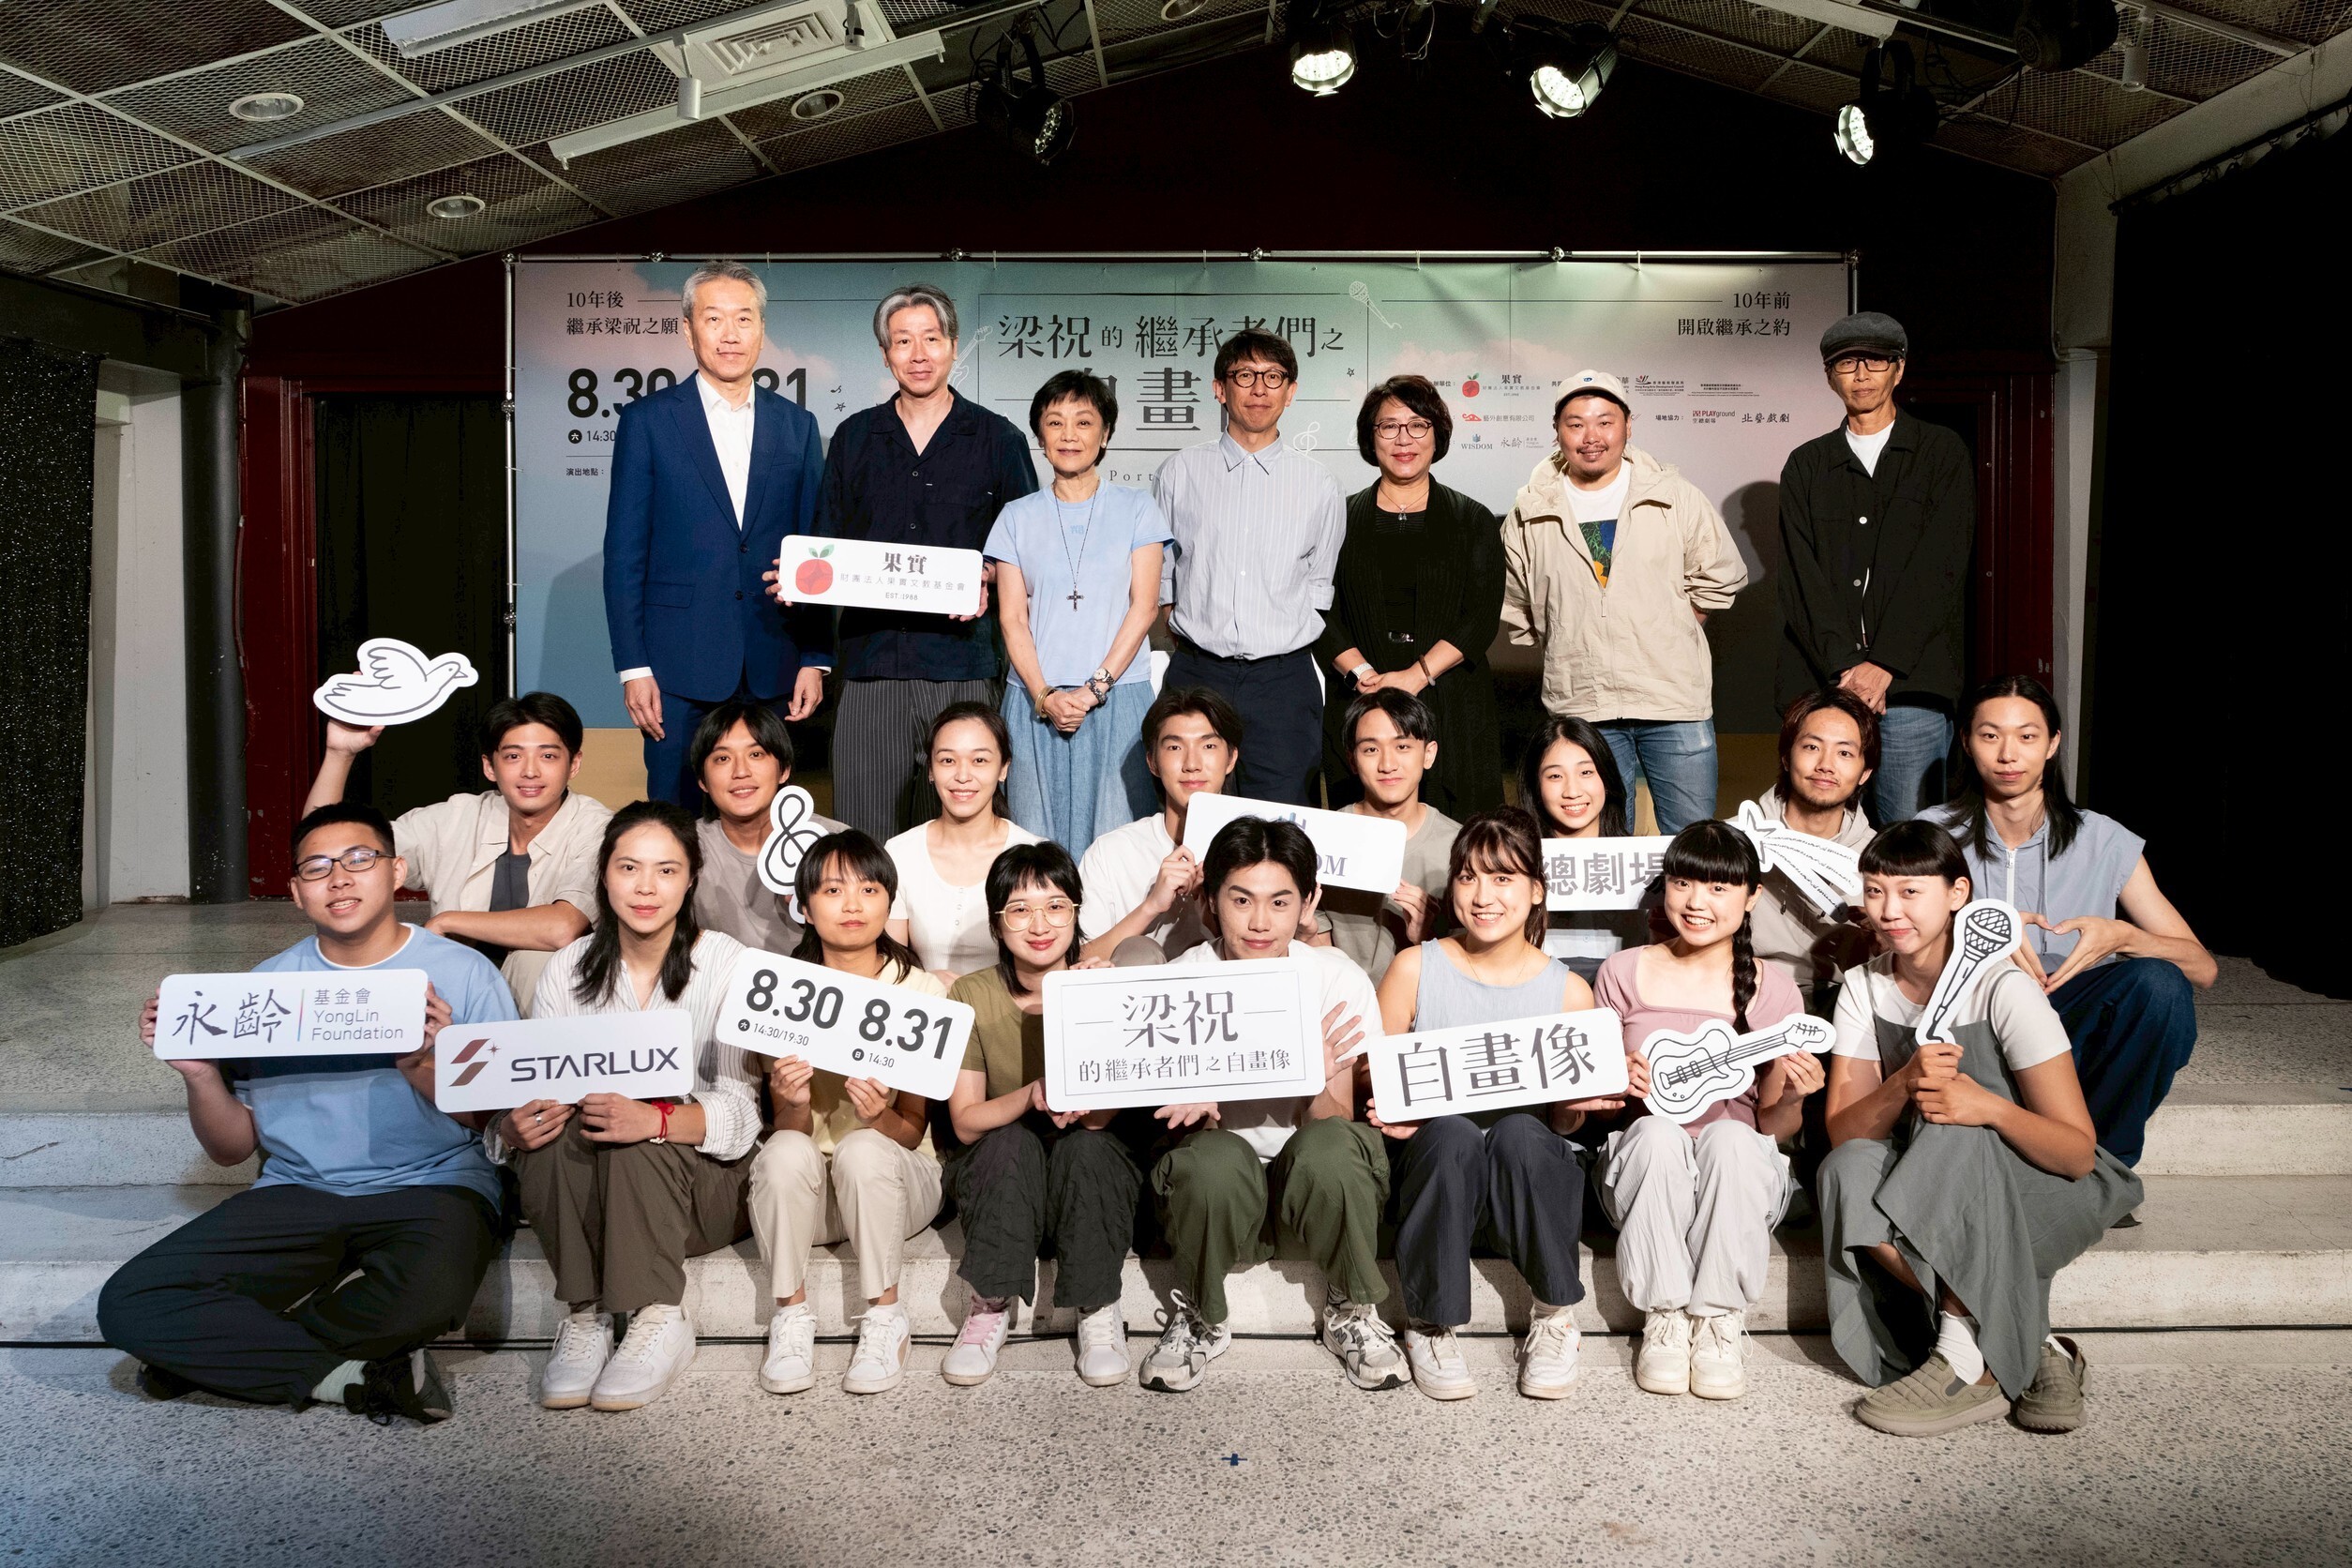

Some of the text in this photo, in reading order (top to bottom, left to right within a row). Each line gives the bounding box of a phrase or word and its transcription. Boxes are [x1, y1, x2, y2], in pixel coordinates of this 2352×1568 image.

[566, 291, 624, 309] 10年後
[1733, 291, 1791, 309] 10年前
[566, 317, 679, 336] 繼承梁祝之願
[1678, 318, 1790, 336] 開啟繼承之約
[882, 551, 927, 575] 果實
[839, 573, 966, 592] 財團法人果實文教基金會
[314, 988, 371, 1005] 基金會
[173, 988, 292, 1045] 永齡
[314, 1010, 379, 1027] YongLin
[746, 969, 954, 1060] 8.30 8.31
[1122, 990, 1239, 1048] 梁祝
[311, 1026, 403, 1041] Foundation
[753, 1023, 809, 1047] 14:30/19:30
[511, 1047, 680, 1082] STARLUX
[868, 1052, 895, 1068] 14:30
[1078, 1048, 1290, 1083] 的繼承者們之自畫像
[1397, 1023, 1595, 1107] 自畫像
